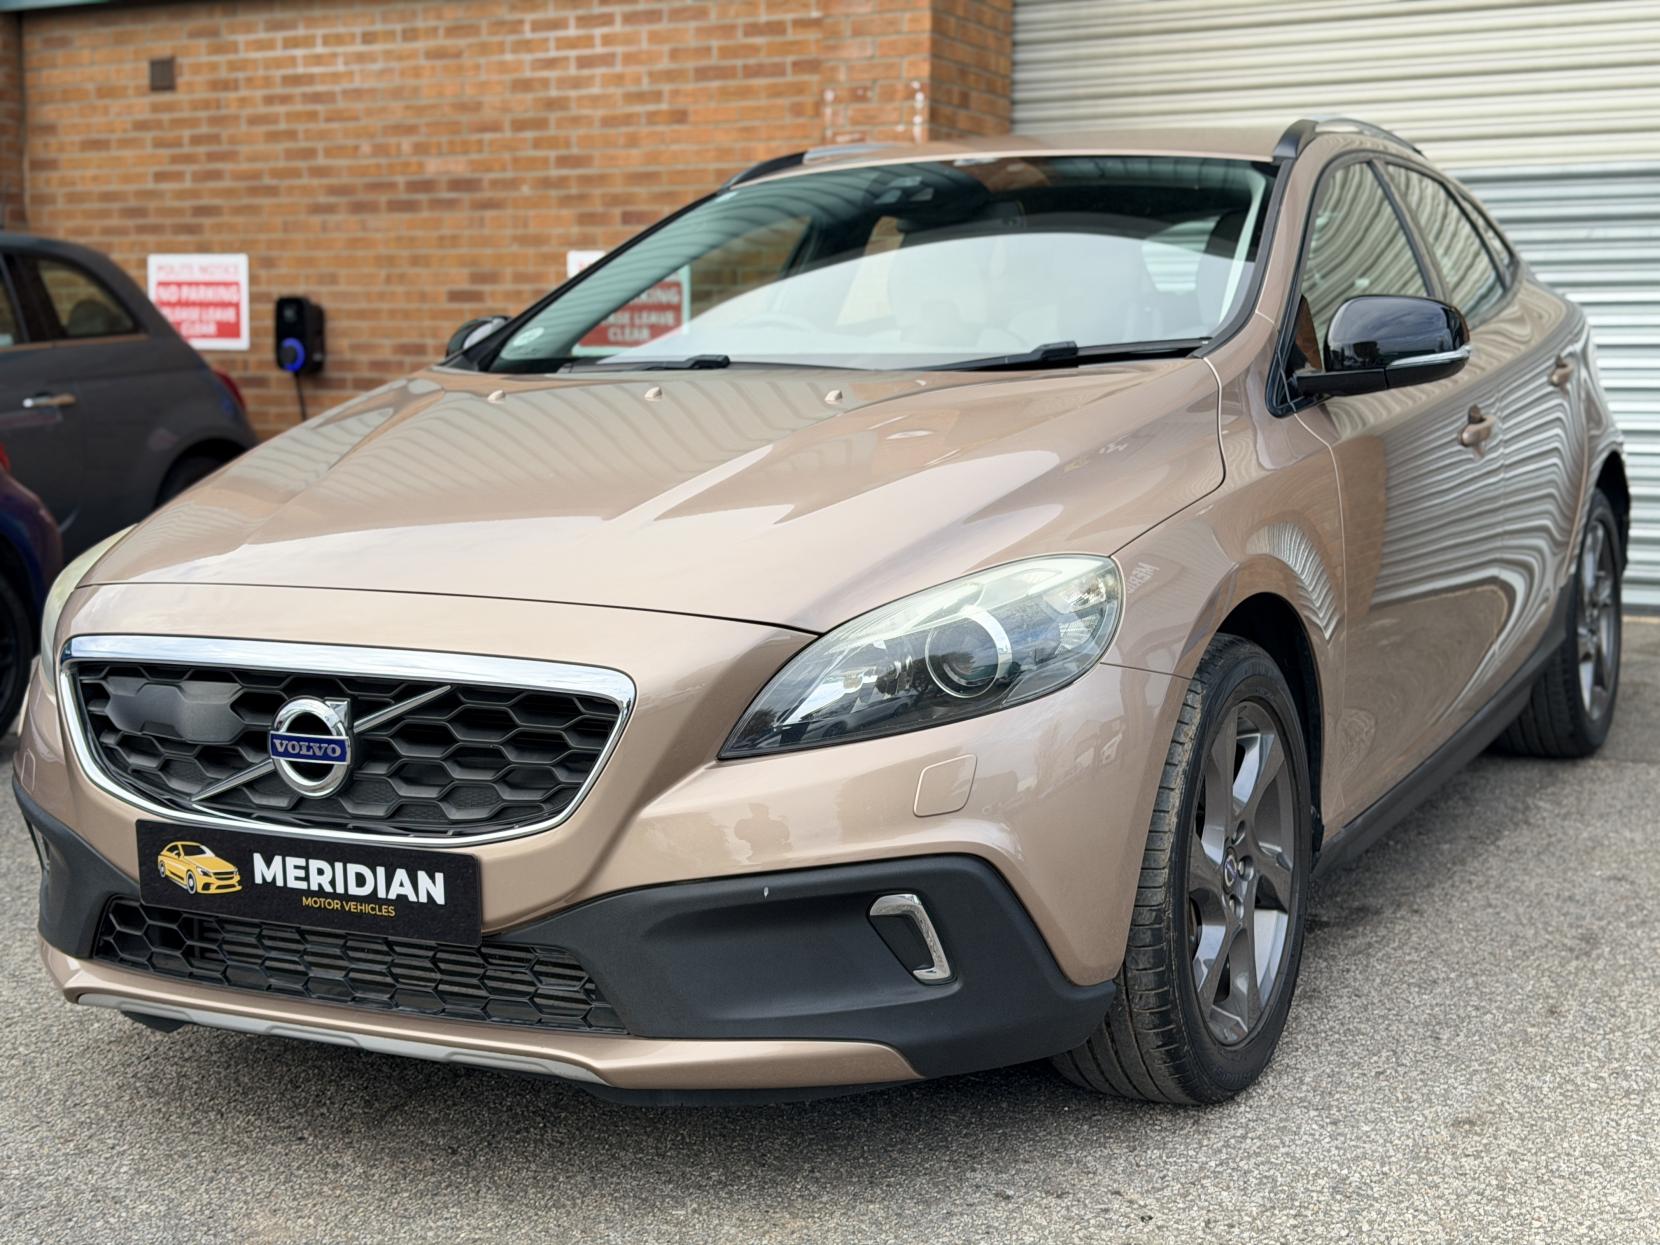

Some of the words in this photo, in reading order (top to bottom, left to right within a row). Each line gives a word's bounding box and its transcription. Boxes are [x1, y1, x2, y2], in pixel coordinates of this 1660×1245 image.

[157, 284, 179, 303] NO
[180, 284, 240, 303] PARKING
[632, 309, 676, 326] LEAVE
[607, 326, 651, 342] CLEAR
[272, 738, 342, 757] VOLVO
[252, 852, 445, 905] MERIDIAN
[302, 895, 341, 911] MOTOR
[343, 901, 396, 917] VEHICLES
